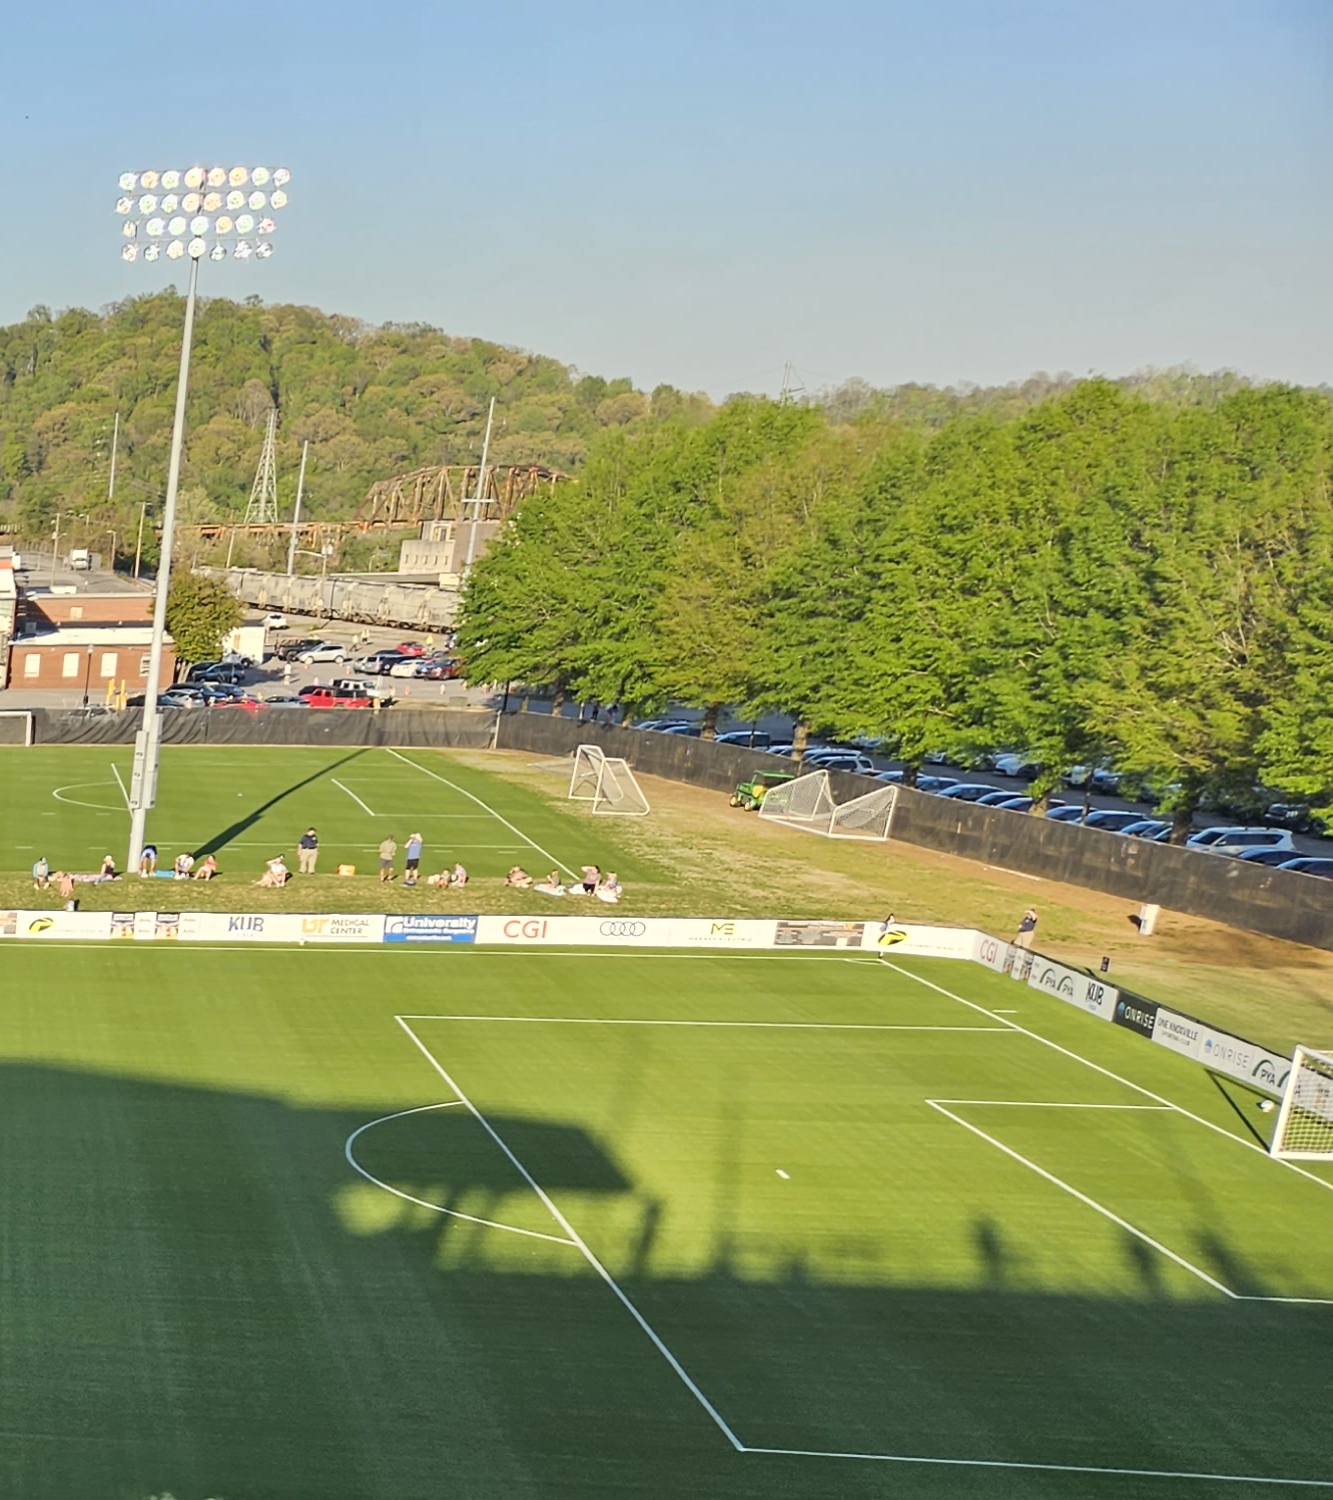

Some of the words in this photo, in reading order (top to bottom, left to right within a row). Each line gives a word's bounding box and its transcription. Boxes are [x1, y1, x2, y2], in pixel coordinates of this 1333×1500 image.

[228, 916, 264, 932] KUB
[330, 927, 363, 935] CENTER
[331, 919, 370, 927] MEDICAL
[403, 916, 476, 929] University
[503, 920, 548, 939] CGI
[980, 939, 999, 964] CGI
[1086, 982, 1105, 1006] KUB
[1125, 1006, 1155, 1029] ONRISE
[1158, 1017, 1170, 1030] ONE
[1170, 1021, 1198, 1041] KNOXVILLE
[1213, 1043, 1250, 1068] ONRISE
[1261, 1069, 1276, 1085] PYA
